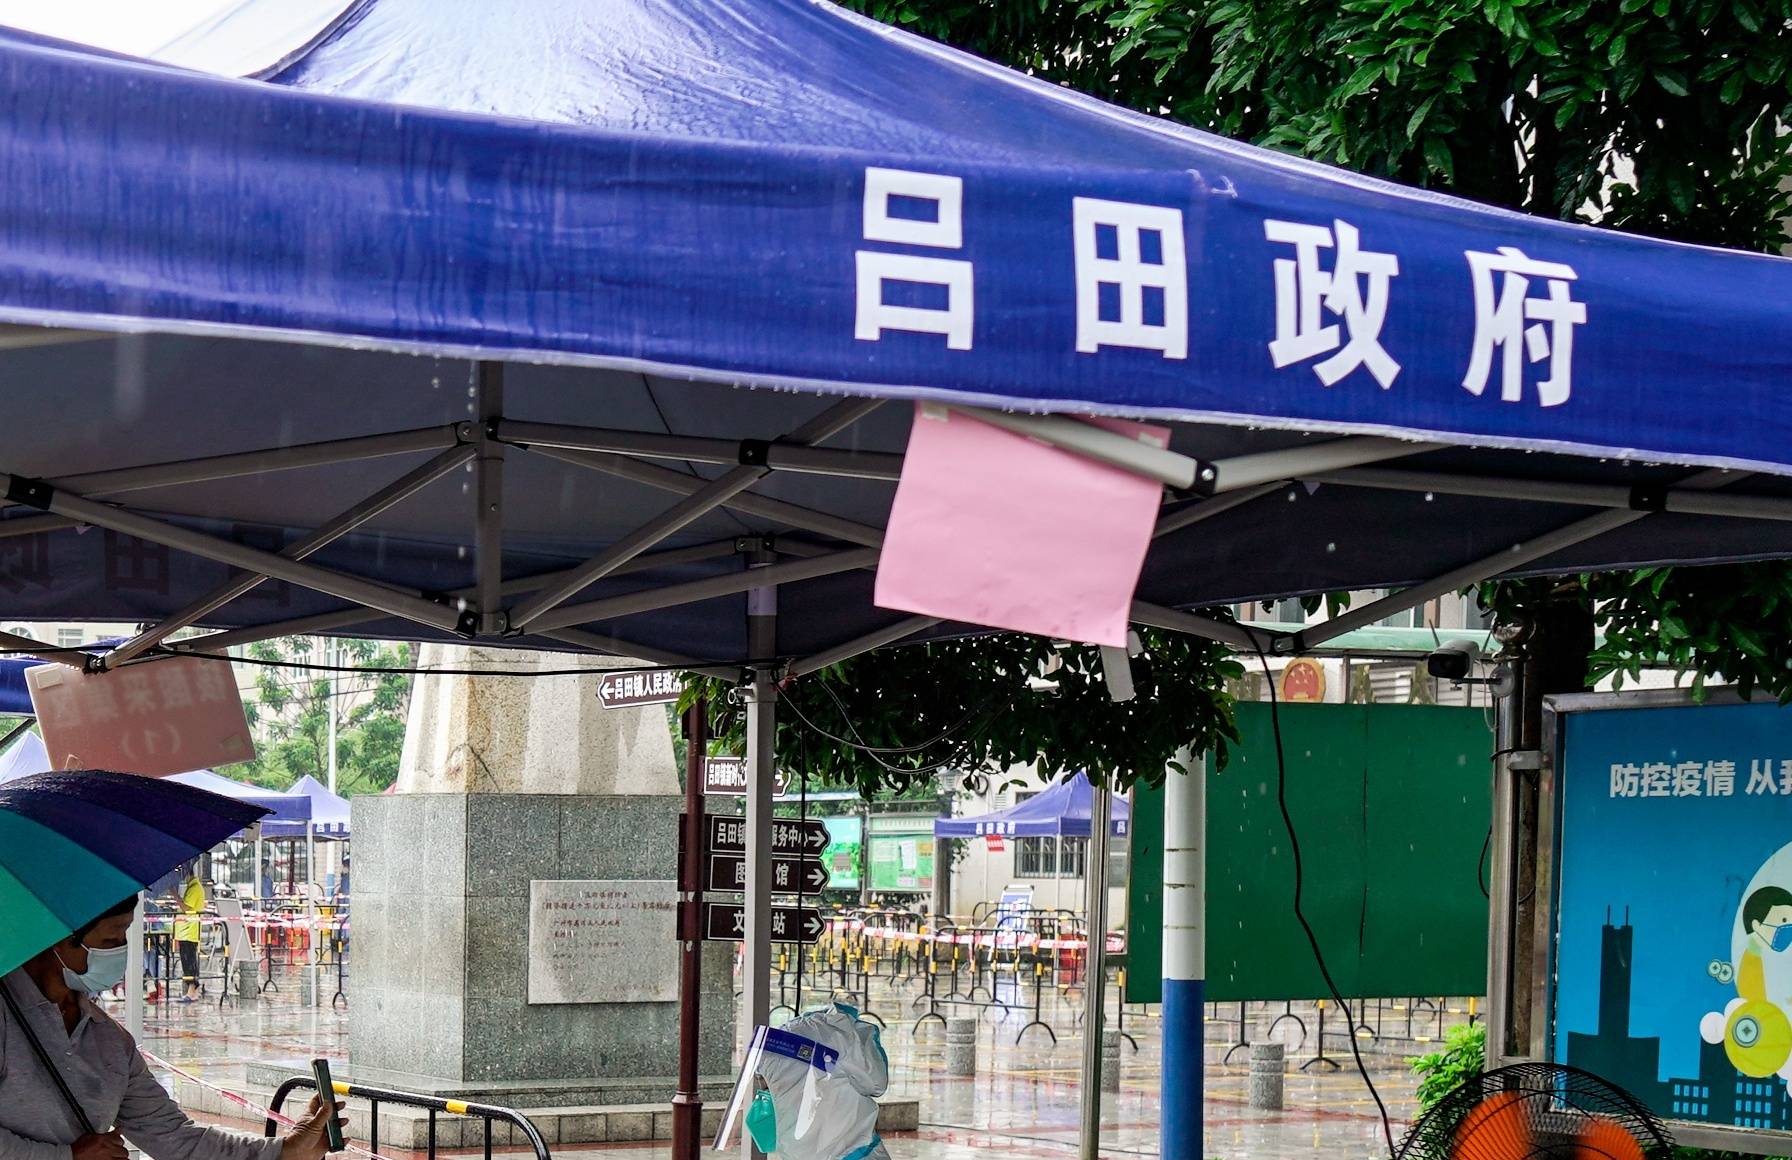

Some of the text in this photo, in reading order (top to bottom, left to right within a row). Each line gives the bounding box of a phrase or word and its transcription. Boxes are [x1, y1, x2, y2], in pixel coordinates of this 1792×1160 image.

[853, 166, 1587, 408] 吕田政府
[1609, 760, 1736, 798] 防控疫情
[735, 862, 789, 886] 图馆
[732, 910, 786, 935] 文站
